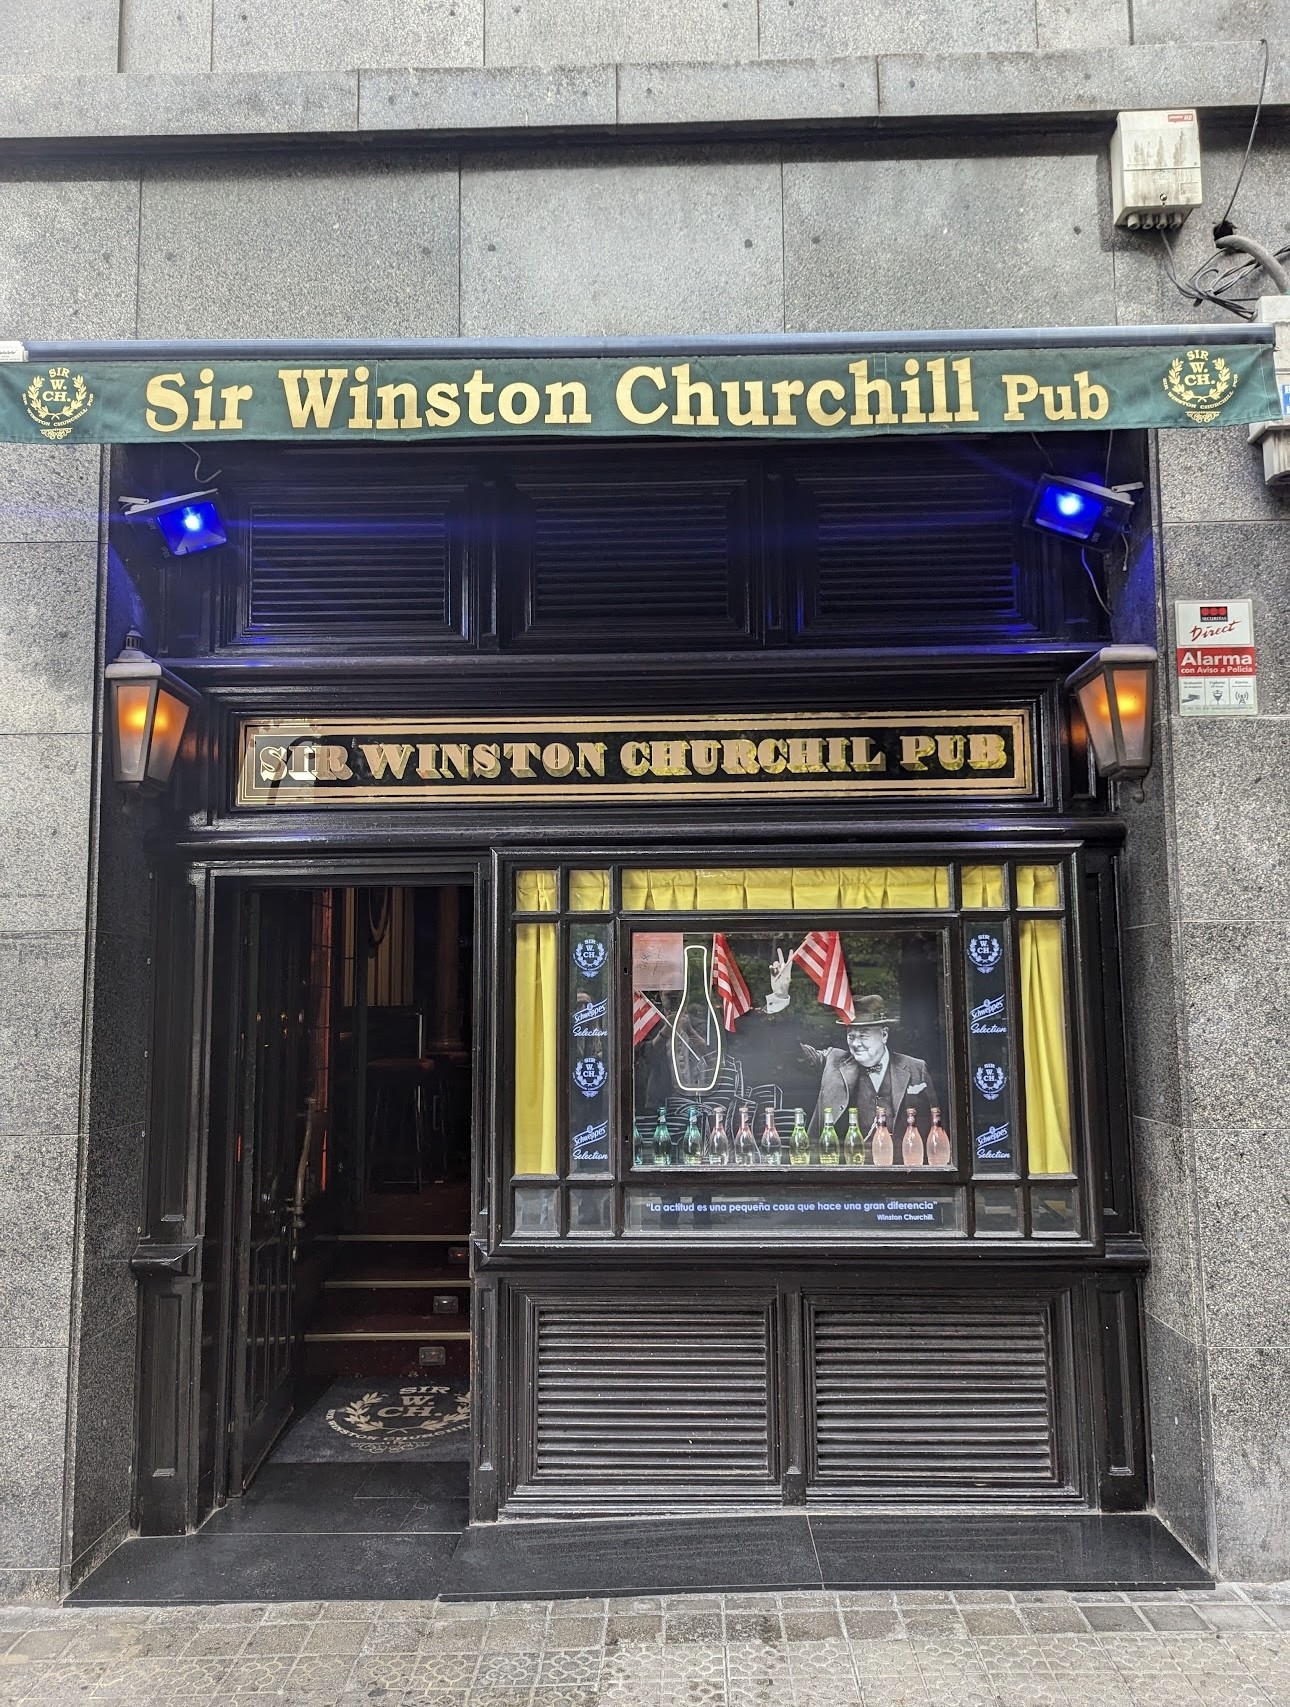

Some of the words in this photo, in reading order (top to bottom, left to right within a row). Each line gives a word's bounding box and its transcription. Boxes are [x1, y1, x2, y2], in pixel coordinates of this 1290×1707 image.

[1186, 350, 1209, 360] SIR
[48, 367, 70, 378] SIR
[1190, 362, 1208, 373] W.
[50, 379, 67, 390] W.
[1184, 374, 1215, 386] CH.
[42, 391, 71, 402] CH.
[146, 368, 253, 432] Sir
[278, 366, 592, 430] Winston
[615, 357, 980, 426] Churchill
[1001, 369, 1110, 422] Pub
[1200, 390, 1234, 409] CHURCHILL
[53, 408, 88, 427] CHURCHILL
[1190, 620, 1242, 642] Direct
[1181, 651, 1252, 666] Alarma
[260, 744, 353, 782] SIR
[358, 742, 608, 780] WINSTON
[620, 736, 886, 776] CHURCHIL
[900, 734, 1008, 772] PUB
[574, 1004, 606, 1023] Schweppes
[971, 1000, 1004, 1020] Schweppes
[573, 1026, 608, 1037] Selection
[970, 1023, 1007, 1034] Selection
[574, 1126, 606, 1146] Schweppes
[977, 1127, 1008, 1146] Schweppes
[572, 1150, 608, 1161] Selection
[976, 1149, 1010, 1160] Selection
[663, 1203, 694, 1212] actitud
[729, 1202, 770, 1213] pequeña
[798, 1203, 815, 1212] que
[817, 1202, 841, 1210] hace
[864, 1203, 885, 1212] gran
[399, 1386, 450, 1394] SIR
[401, 1396, 435, 1406] W.
[377, 1406, 442, 1417] CH.
